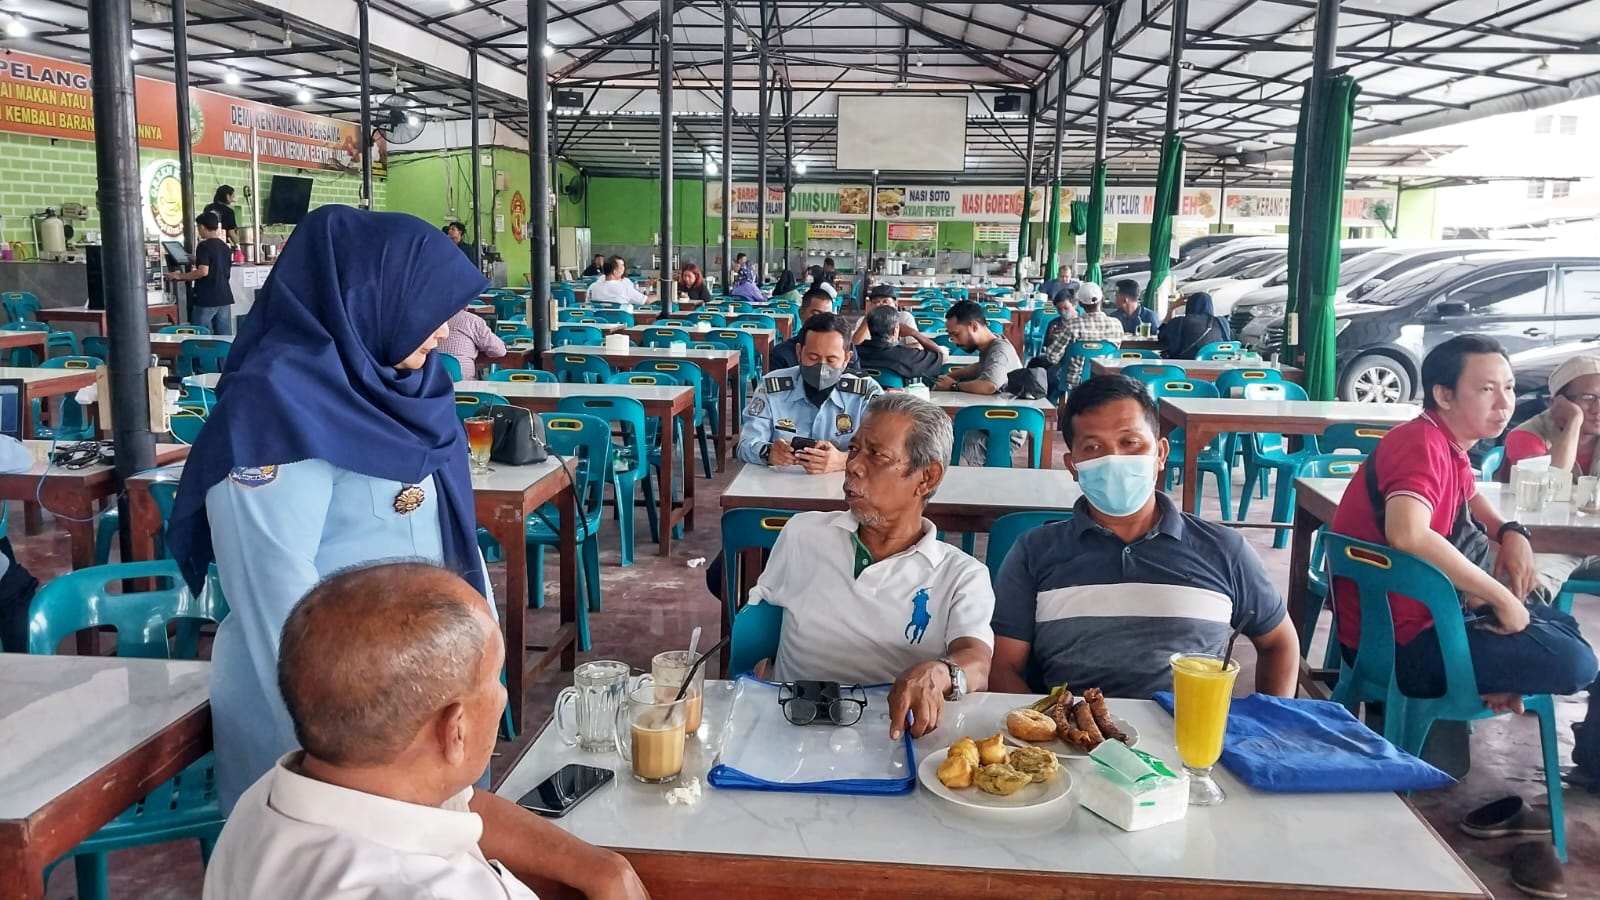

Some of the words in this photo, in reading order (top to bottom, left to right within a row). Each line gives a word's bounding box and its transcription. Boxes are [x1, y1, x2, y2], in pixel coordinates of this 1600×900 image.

[0, 60, 94, 89] PELANG
[0, 82, 12, 98] AI
[15, 84, 57, 105] MAKAN
[60, 91, 87, 109] ATAU
[5, 105, 56, 127] KEMBALI
[59, 112, 95, 132] BARAN
[138, 124, 162, 140] NNYA
[256, 110, 307, 137] KENYAMANAN
[309, 121, 341, 143] BERSAMA
[223, 130, 247, 153] MOHON
[248, 134, 268, 156] UTUK
[268, 139, 285, 158] TIDAK
[737, 187, 758, 199] SARAP
[790, 192, 840, 213] DIMSUM
[909, 190, 928, 201] NASI
[929, 190, 950, 201] SOTO
[737, 201, 758, 214] LONTON
[925, 205, 956, 217] PENYET
[961, 194, 983, 214] NASI
[985, 194, 1023, 214] GORENG
[1116, 194, 1140, 215] TELUR
[1256, 197, 1283, 216] KERANG
